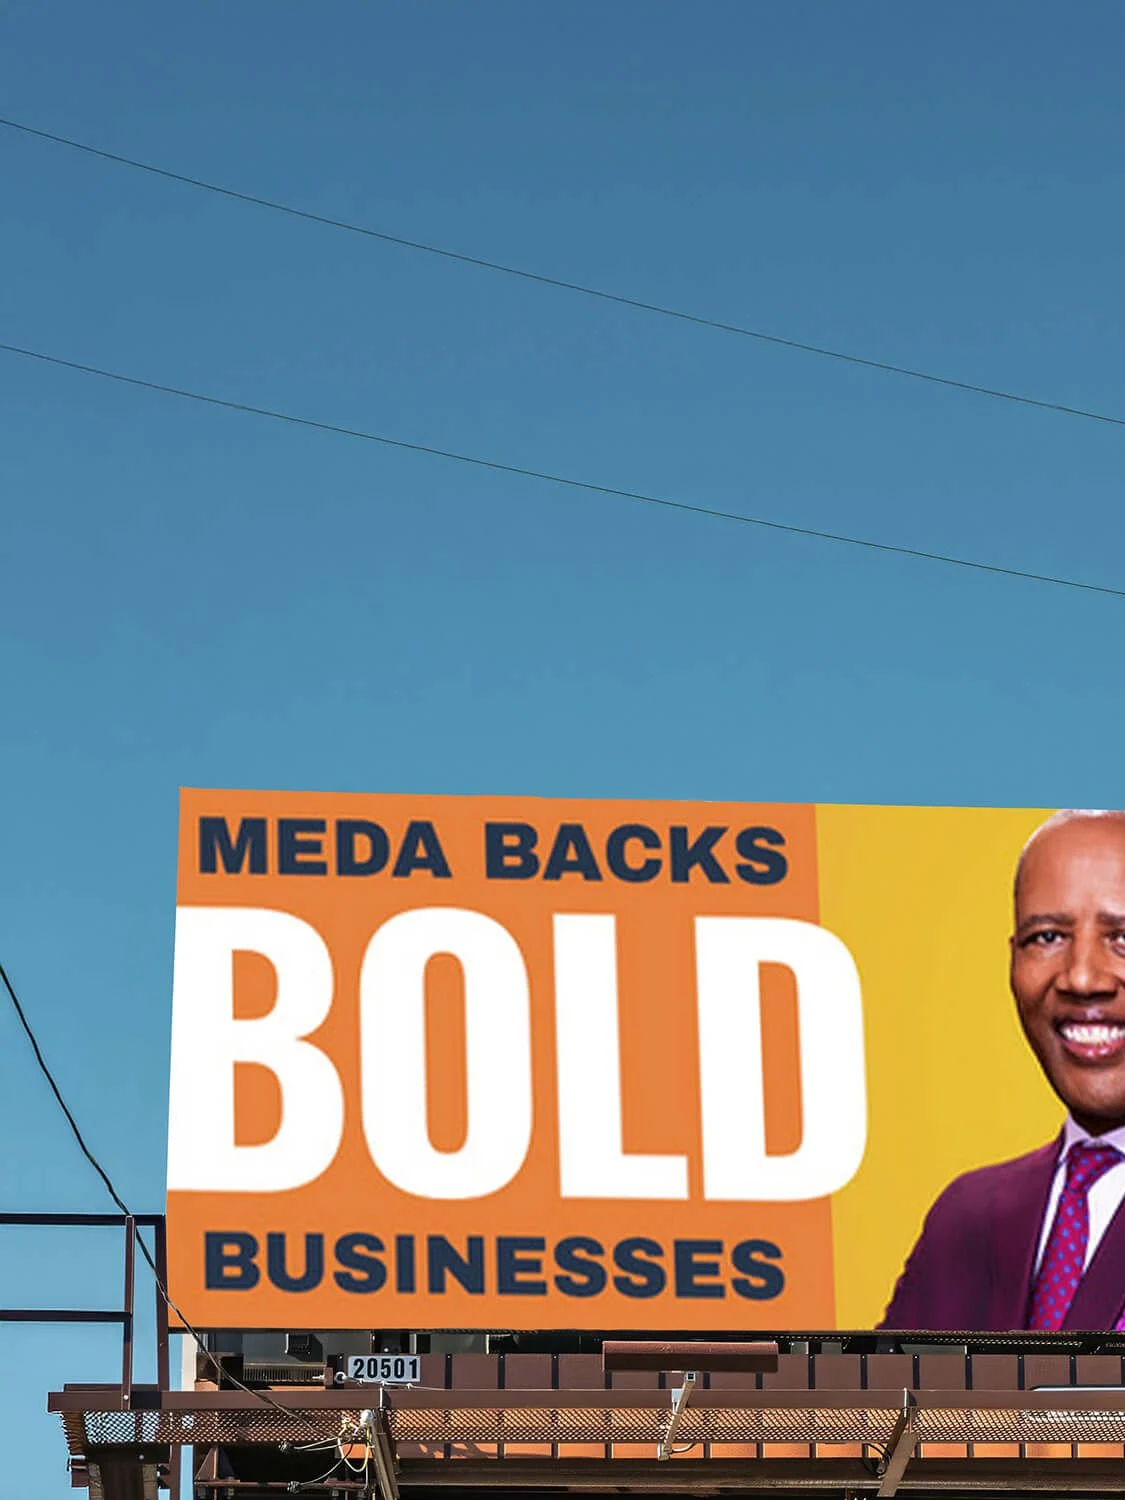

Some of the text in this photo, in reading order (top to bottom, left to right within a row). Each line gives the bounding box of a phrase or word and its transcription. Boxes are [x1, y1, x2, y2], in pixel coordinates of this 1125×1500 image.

[198, 815, 789, 887] MEDA BACKS
[167, 905, 869, 1203] BOLD
[203, 1230, 786, 1302] BUSINESSES
[353, 1357, 418, 1379] 20501
